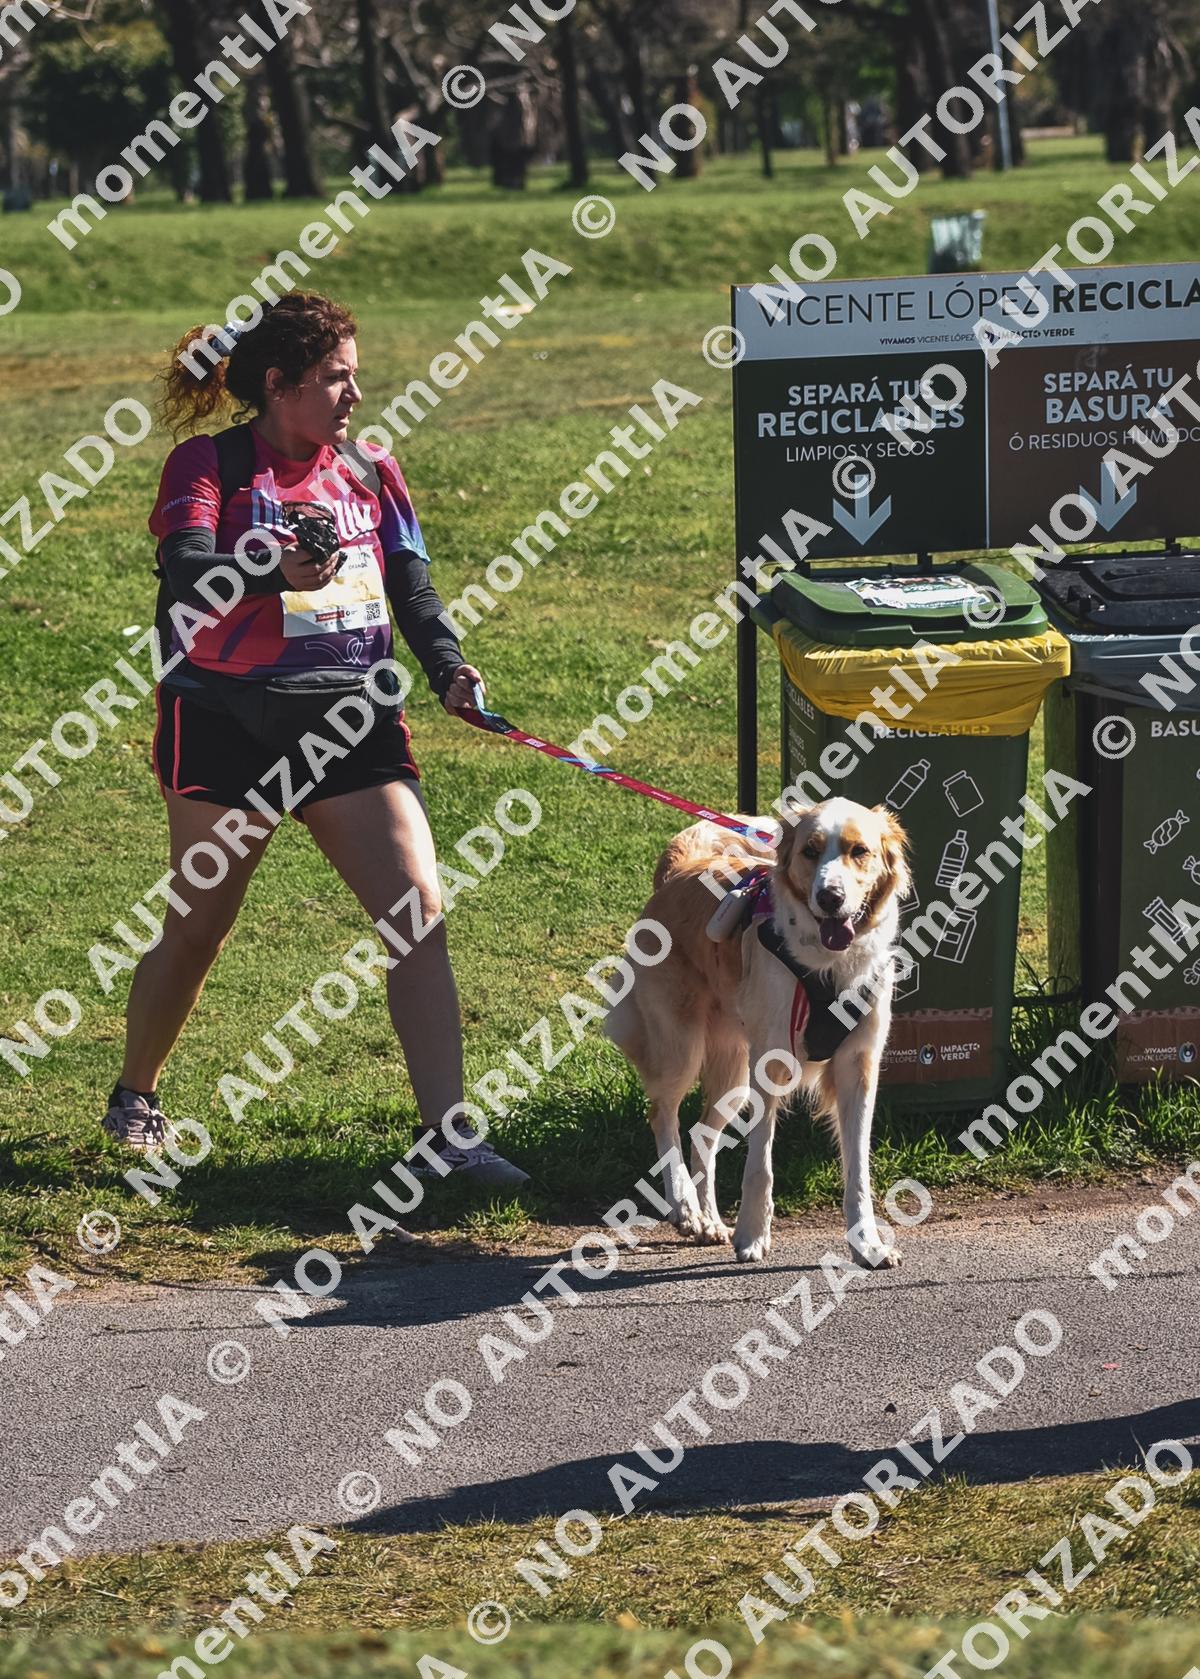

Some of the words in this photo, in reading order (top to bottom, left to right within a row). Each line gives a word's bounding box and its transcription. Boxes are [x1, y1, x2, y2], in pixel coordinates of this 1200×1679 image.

[758, 292, 915, 327] VICENTE
[929, 281, 1041, 320] LÓPEZ
[879, 336, 915, 346] VIVAMOS
[917, 334, 950, 344] VICENTE
[950, 332, 975, 342] LÓPEZ
[1043, 327, 1075, 338] VERDE
[788, 376, 884, 406] SEPARÁ
[889, 378, 934, 402] TUS
[1044, 363, 1138, 394] SEPARÁ
[1142, 367, 1174, 388] TU
[757, 403, 966, 438] RECICLABLES
[1045, 393, 1175, 425] BASURA
[785, 443, 857, 463] LIMPIOS
[860, 442, 874, 458] Y
[876, 439, 936, 459] SECOS
[1008, 431, 1025, 451] Ó
[1028, 430, 1118, 450] RESIDUOS
[940, 1052, 971, 1061] VERDE
